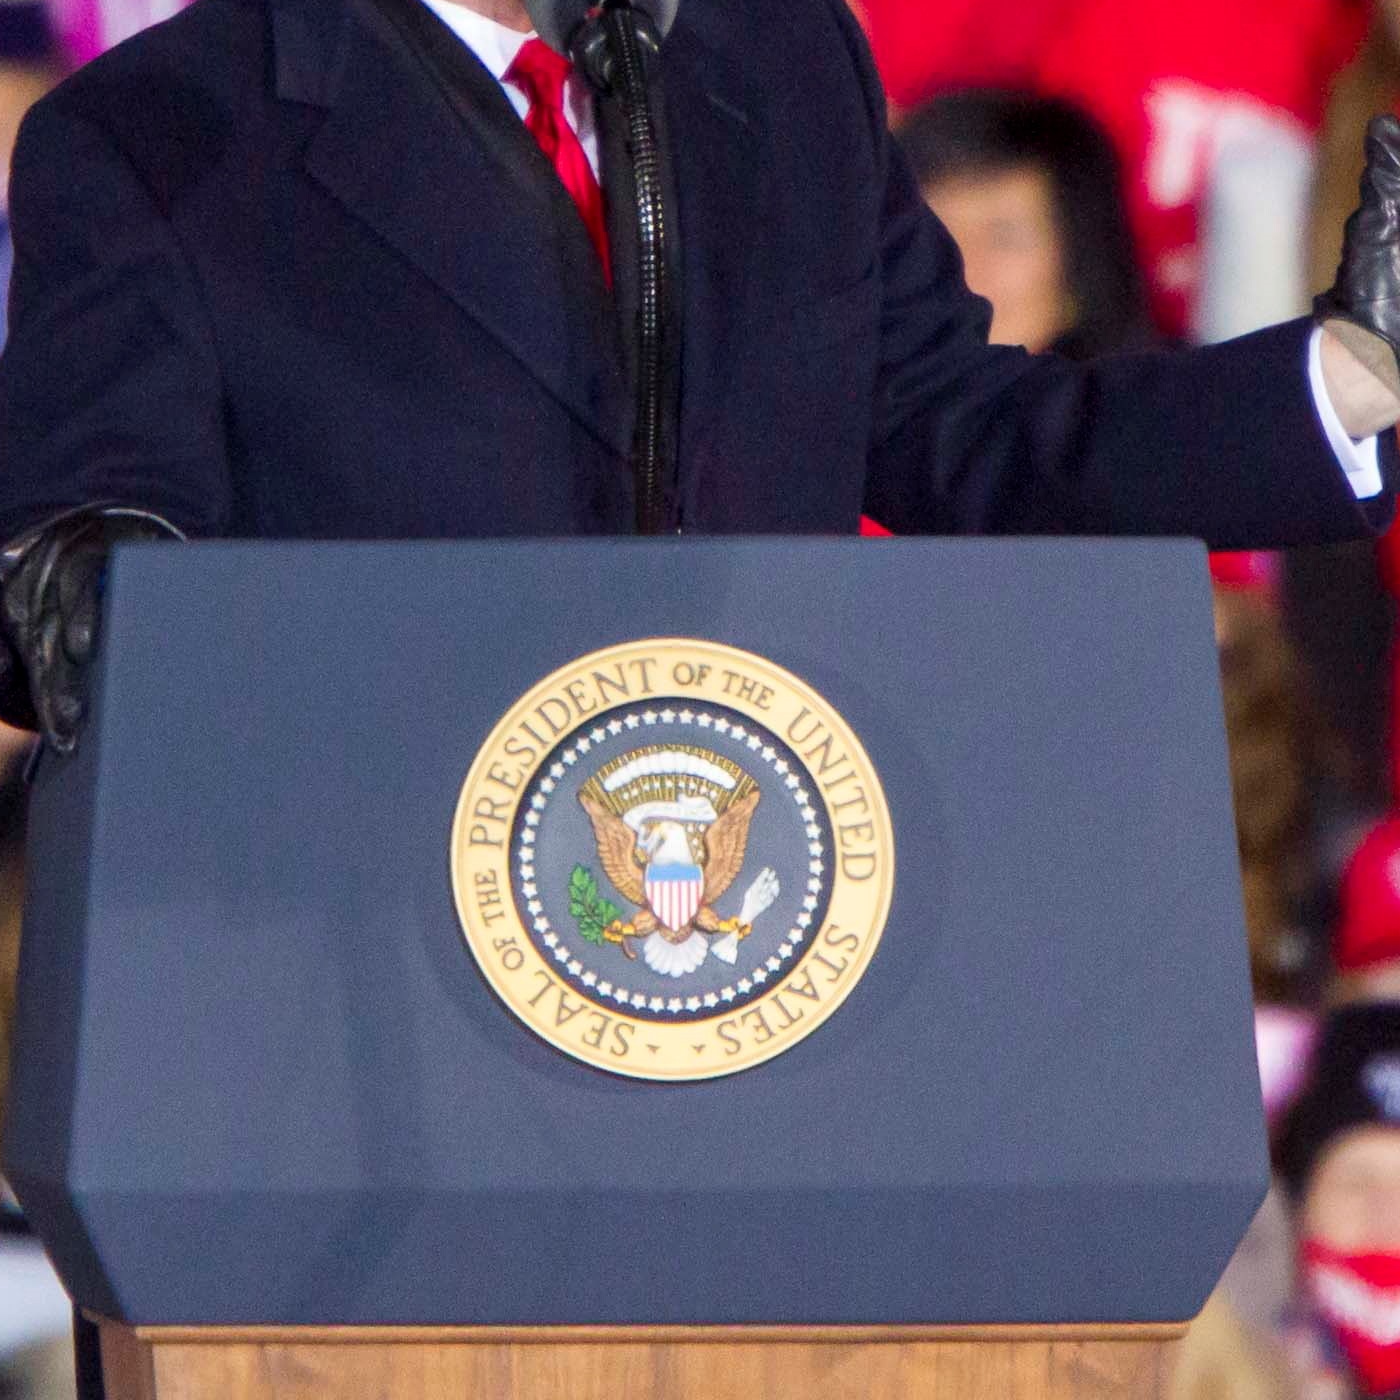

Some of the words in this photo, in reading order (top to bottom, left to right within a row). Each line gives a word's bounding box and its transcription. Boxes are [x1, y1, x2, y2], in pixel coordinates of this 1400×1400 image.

[672, 661, 712, 687] OF
[721, 669, 776, 712] THE
[469, 656, 657, 849] PRESIDENT
[786, 705, 877, 882] UNITED
[474, 868, 506, 928] THE
[493, 936, 525, 971] OF
[715, 923, 859, 1057] STATES
[528, 969, 636, 1057] SEAL
